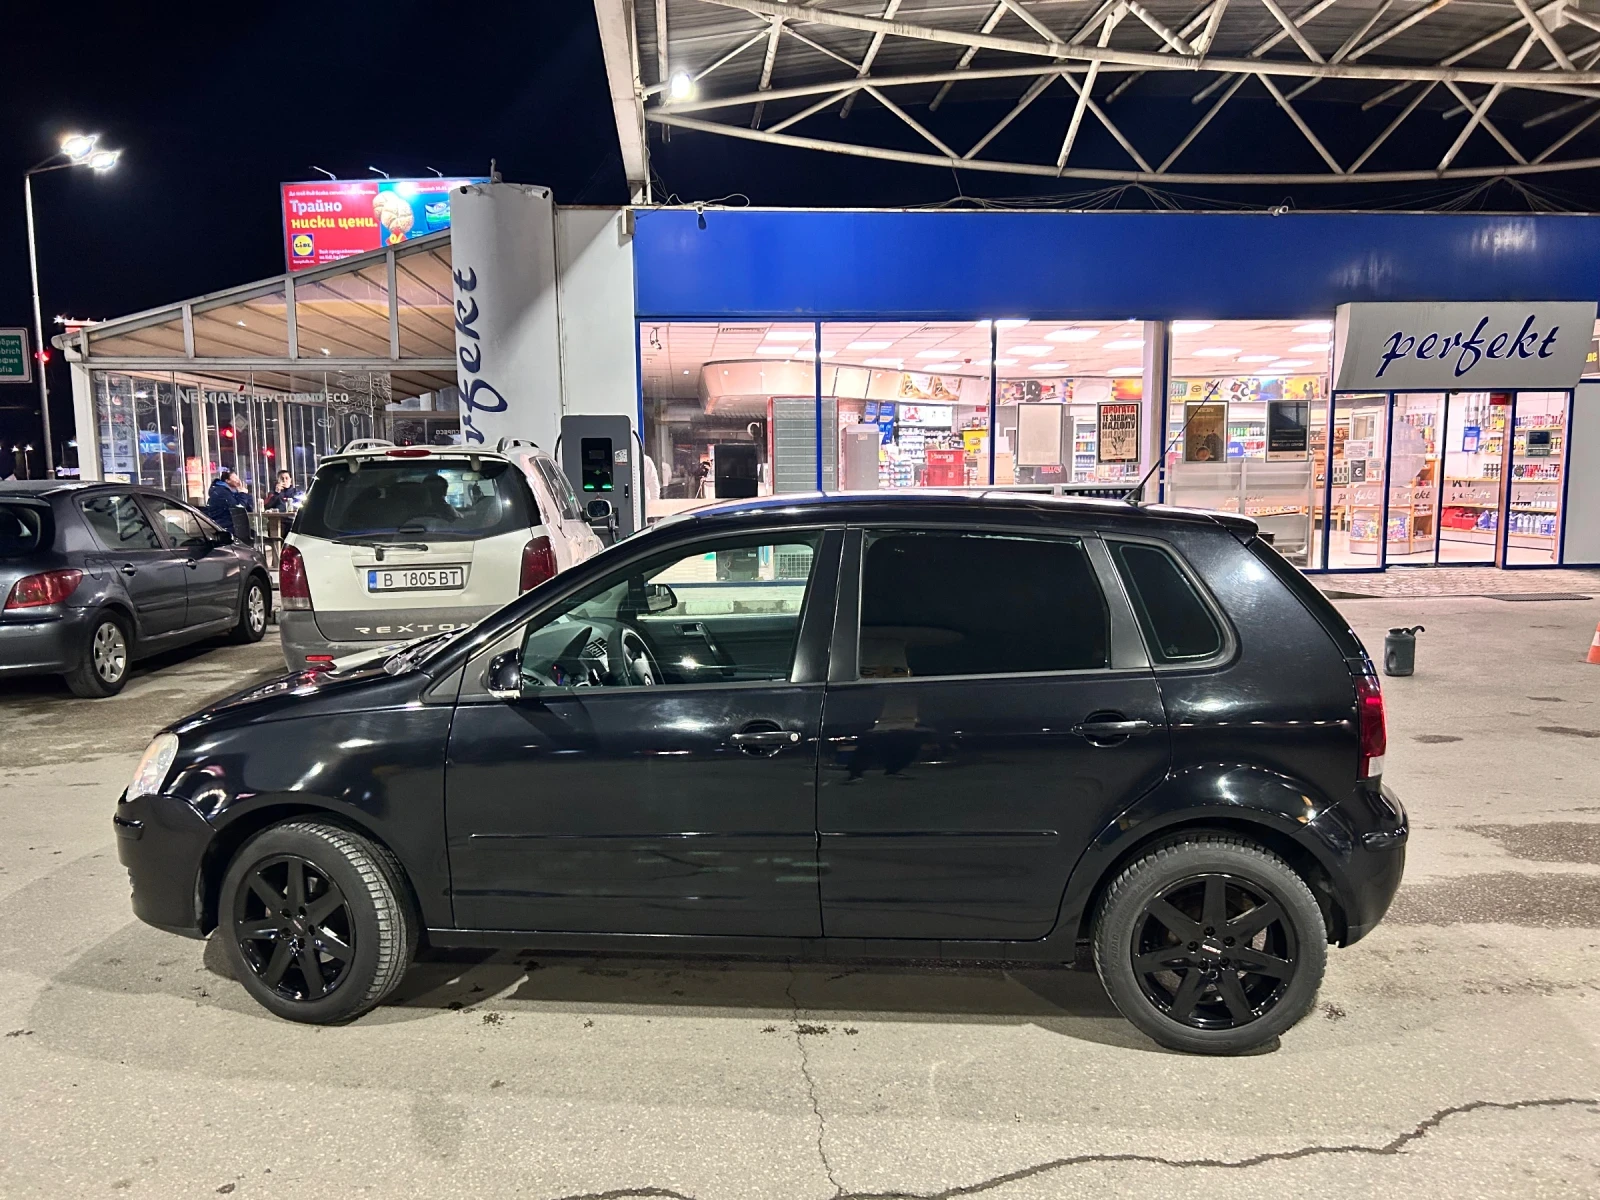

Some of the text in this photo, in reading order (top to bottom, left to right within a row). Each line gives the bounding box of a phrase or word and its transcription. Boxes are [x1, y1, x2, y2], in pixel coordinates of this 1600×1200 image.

[289, 199, 342, 215] Трайно
[290, 215, 377, 230] ниски цени.
[0, 338, 20, 346] брич
[1375, 314, 1560, 378] perfekt
[1102, 405, 1135, 414] ДРОГАТА
[1102, 422, 1135, 430] НАДОЛУ
[383, 573, 393, 587] B
[403, 572, 436, 586] 1805
[440, 571, 458, 585] BT
